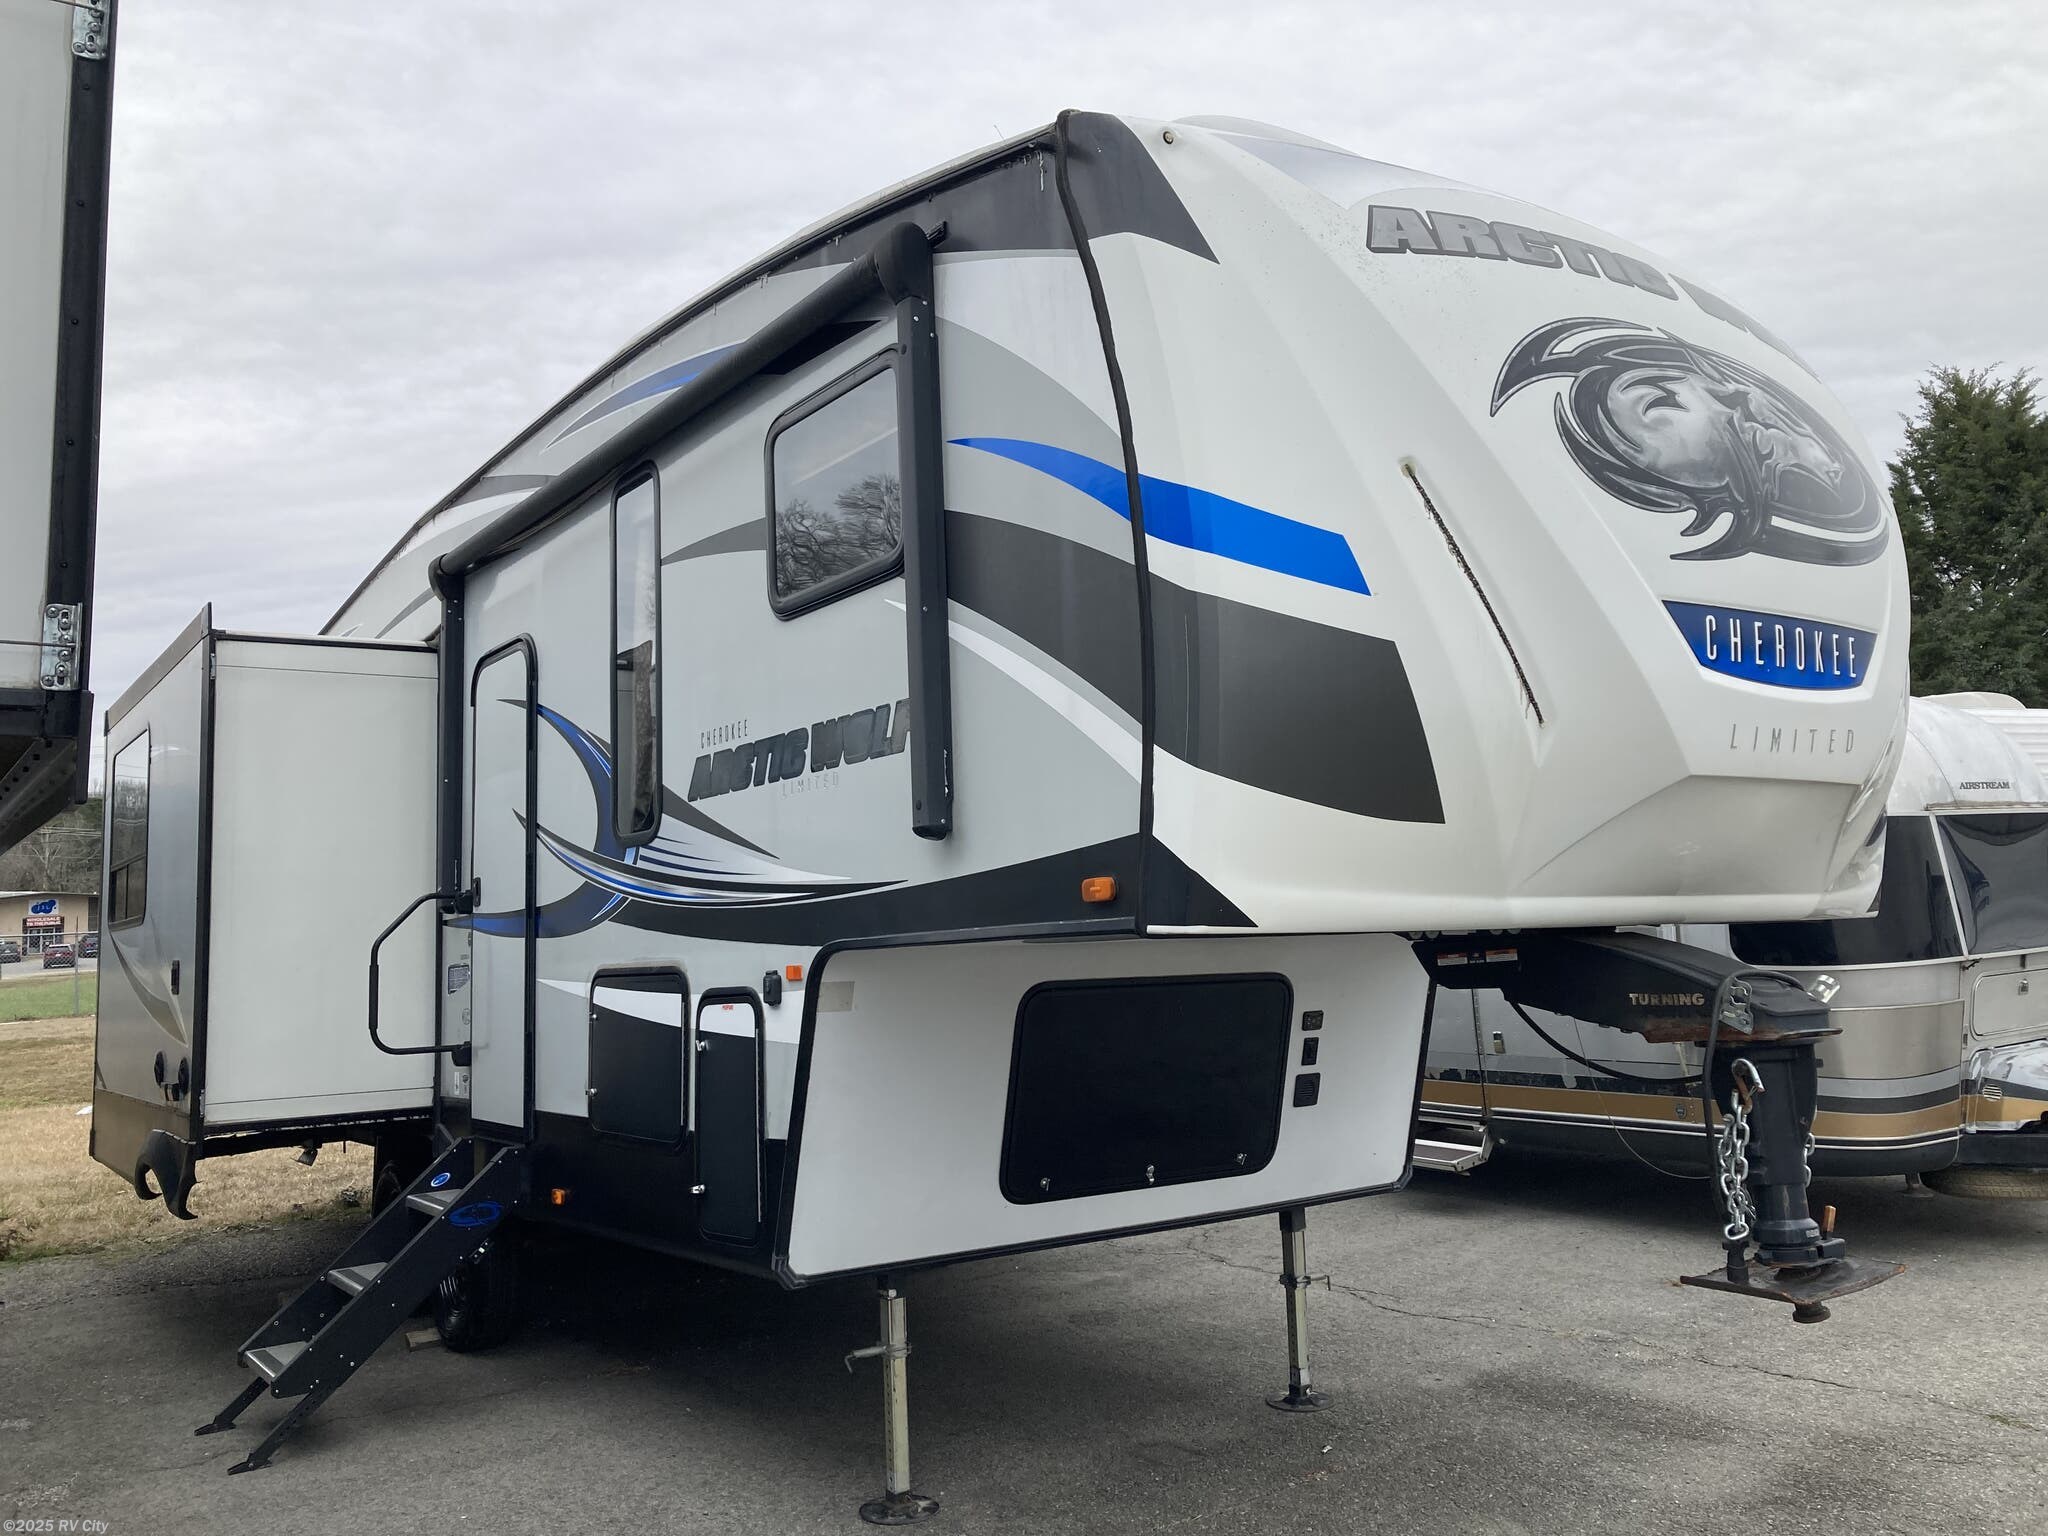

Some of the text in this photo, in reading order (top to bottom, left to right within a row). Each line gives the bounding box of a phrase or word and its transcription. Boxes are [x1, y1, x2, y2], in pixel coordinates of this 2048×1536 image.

[1366, 204, 1679, 301] ARCTIC
[1705, 614, 1857, 679] CHEROKEE
[700, 717, 749, 749] CHEROKEE
[1729, 723, 1855, 754] LIMITED
[687, 727, 809, 802] ARCTIC
[781, 771, 840, 799] LIMITED
[1959, 781, 2010, 790] AIRSTREAM
[1628, 992, 1705, 1006] TURNING
